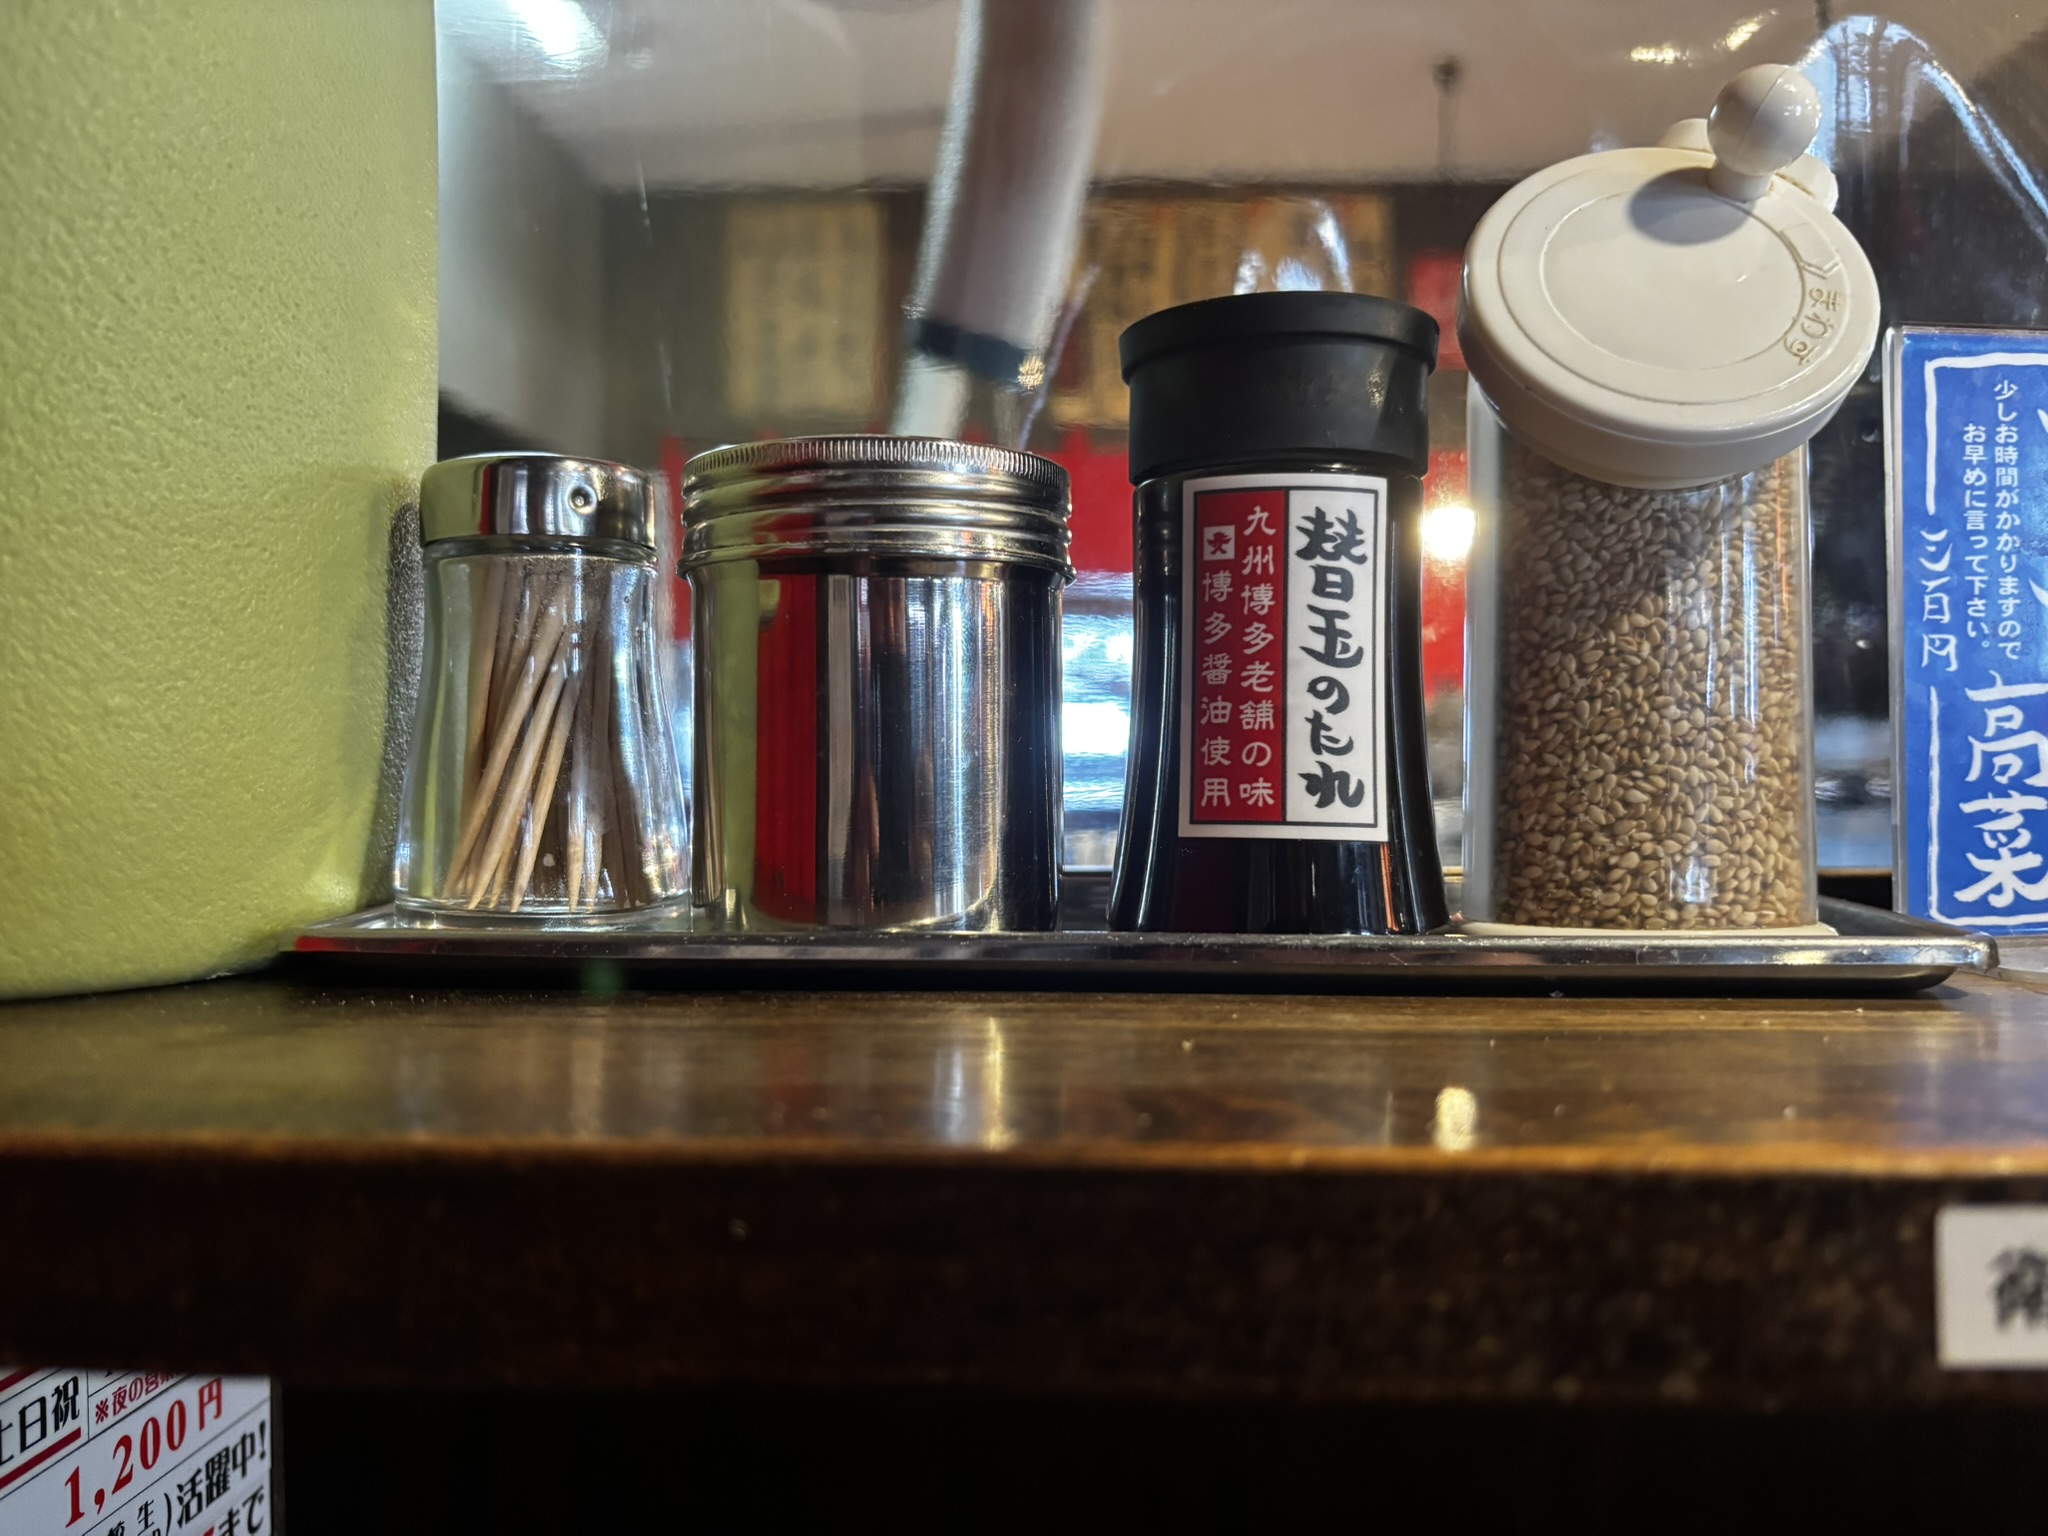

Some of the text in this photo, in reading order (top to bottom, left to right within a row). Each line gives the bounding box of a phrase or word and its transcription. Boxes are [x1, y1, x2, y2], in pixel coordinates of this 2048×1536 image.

[1962, 422, 1990, 648] お早めに言って下さい。
[1993, 379, 2021, 660] 少しお時間がかかりますので
[1200, 570, 1235, 808] 博多醤油使用
[1239, 505, 1277, 808] 九州博多老舗の味
[1295, 505, 1368, 810] 替玉のたれ
[1953, 669, 2048, 909] 高菜
[64, 1376, 223, 1528] 1,200円
